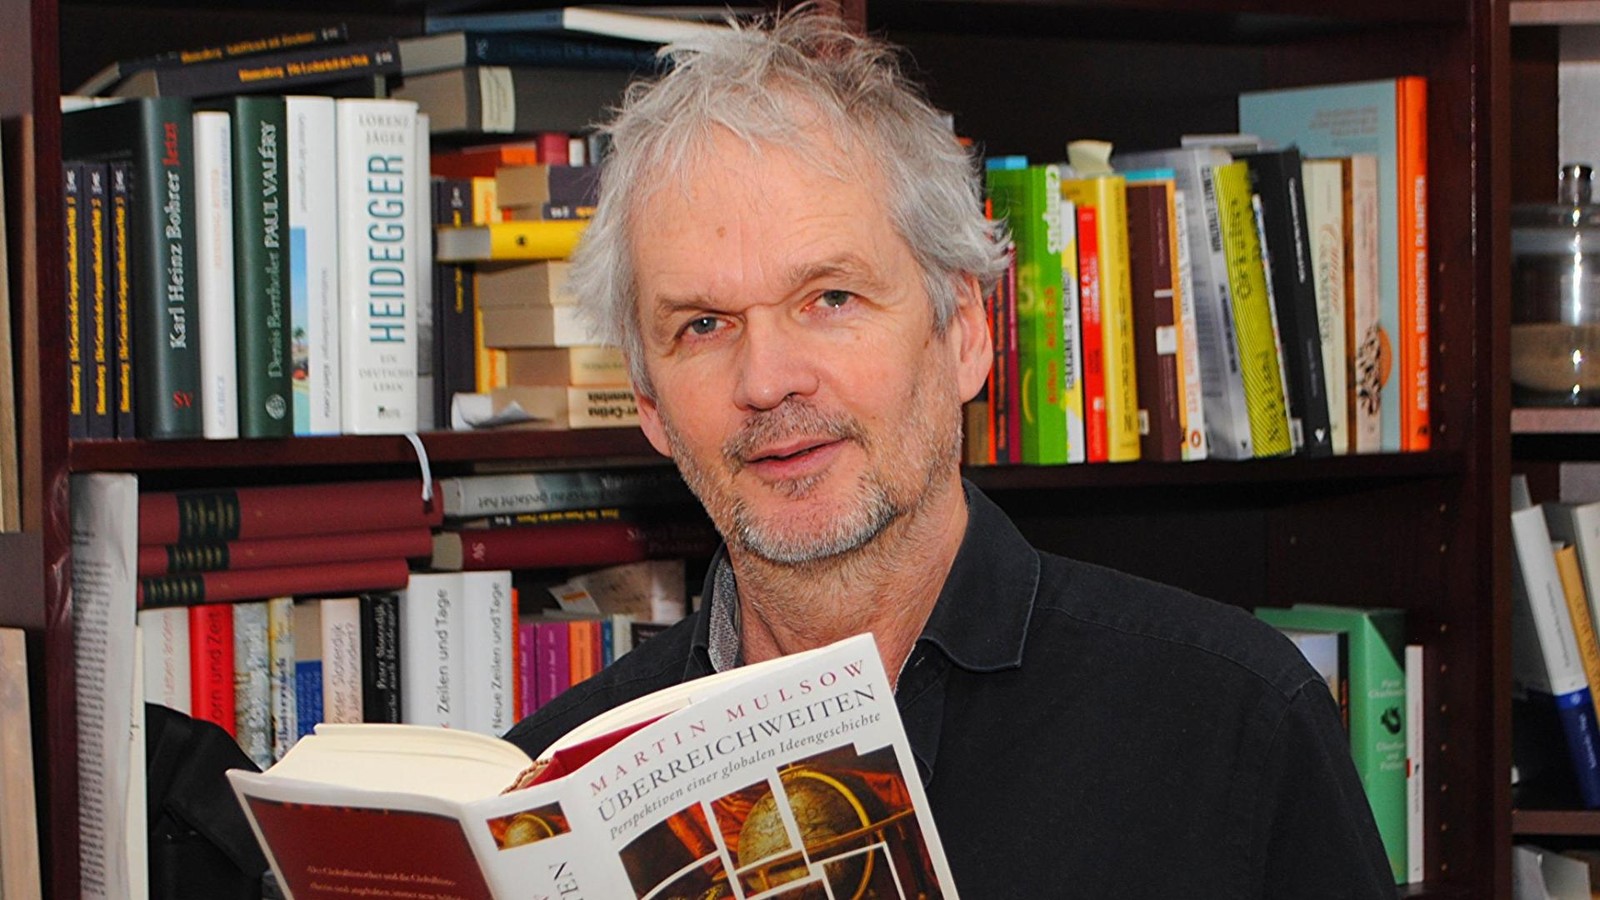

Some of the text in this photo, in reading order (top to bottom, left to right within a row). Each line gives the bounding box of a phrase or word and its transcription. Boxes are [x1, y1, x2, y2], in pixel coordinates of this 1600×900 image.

[257, 121, 278, 196] VALÉRY
[358, 114, 410, 128] LORENZ
[162, 122, 187, 349] Karl Heinz Bohrer Jetzt
[262, 196, 280, 248] PAUL
[368, 154, 406, 344] HEIDEGGER
[1045, 164, 1061, 254] campus
[268, 331, 283, 378] Denis
[478, 495, 498, 508] hat
[206, 612, 223, 720] orn und Zeit
[435, 588, 450, 714] Zeilen und Tage
[489, 582, 503, 729] Neue Zeilen und Tage
[589, 659, 865, 797] MARTIN MULSOW
[598, 683, 878, 823] ÜBERREICHWEITEN
[610, 710, 882, 841] Perspektiven einer globalen Ideengeschichte
